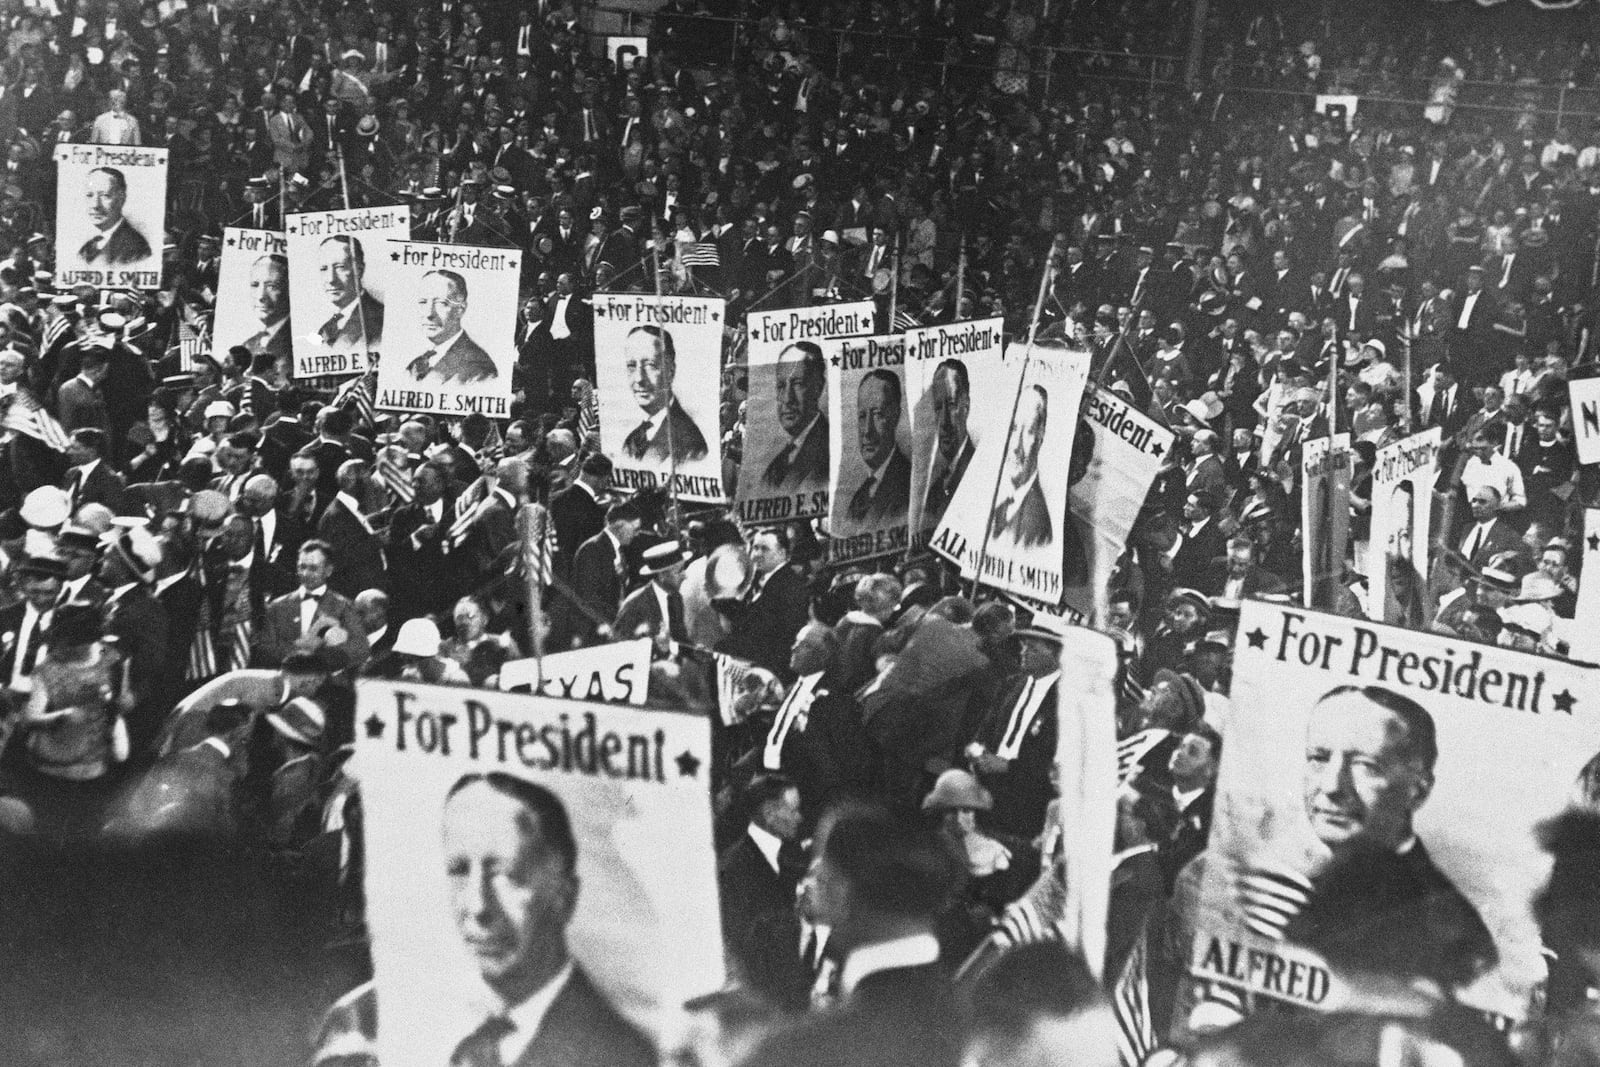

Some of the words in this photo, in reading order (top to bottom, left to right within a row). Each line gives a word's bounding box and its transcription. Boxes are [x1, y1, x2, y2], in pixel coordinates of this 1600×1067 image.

[73, 146, 92, 164] For
[96, 147, 155, 166] President
[301, 215, 322, 236] For
[326, 210, 394, 233] President
[238, 230, 262, 250] For
[403, 245, 428, 266] For
[432, 246, 505, 271] President
[62, 270, 103, 286] ALFRED
[119, 271, 158, 286] SMITH
[608, 297, 632, 321] For
[636, 297, 707, 324] President
[762, 315, 786, 343] For
[790, 308, 859, 339] President
[917, 331, 937, 360] For
[939, 324, 992, 356] President
[300, 354, 347, 374] ALFRED
[352, 352, 363, 370] E.
[842, 341, 865, 370] For
[379, 389, 434, 409] ALFRED
[439, 393, 451, 410] E.
[454, 394, 506, 414] SMITH
[675, 473, 721, 498] SMITH
[740, 496, 792, 520] ALFRED
[1277, 611, 1342, 670] For
[1349, 627, 1545, 713] President
[394, 690, 457, 757] For
[465, 699, 666, 784] President
[1202, 936, 1331, 1004] ALFRED
